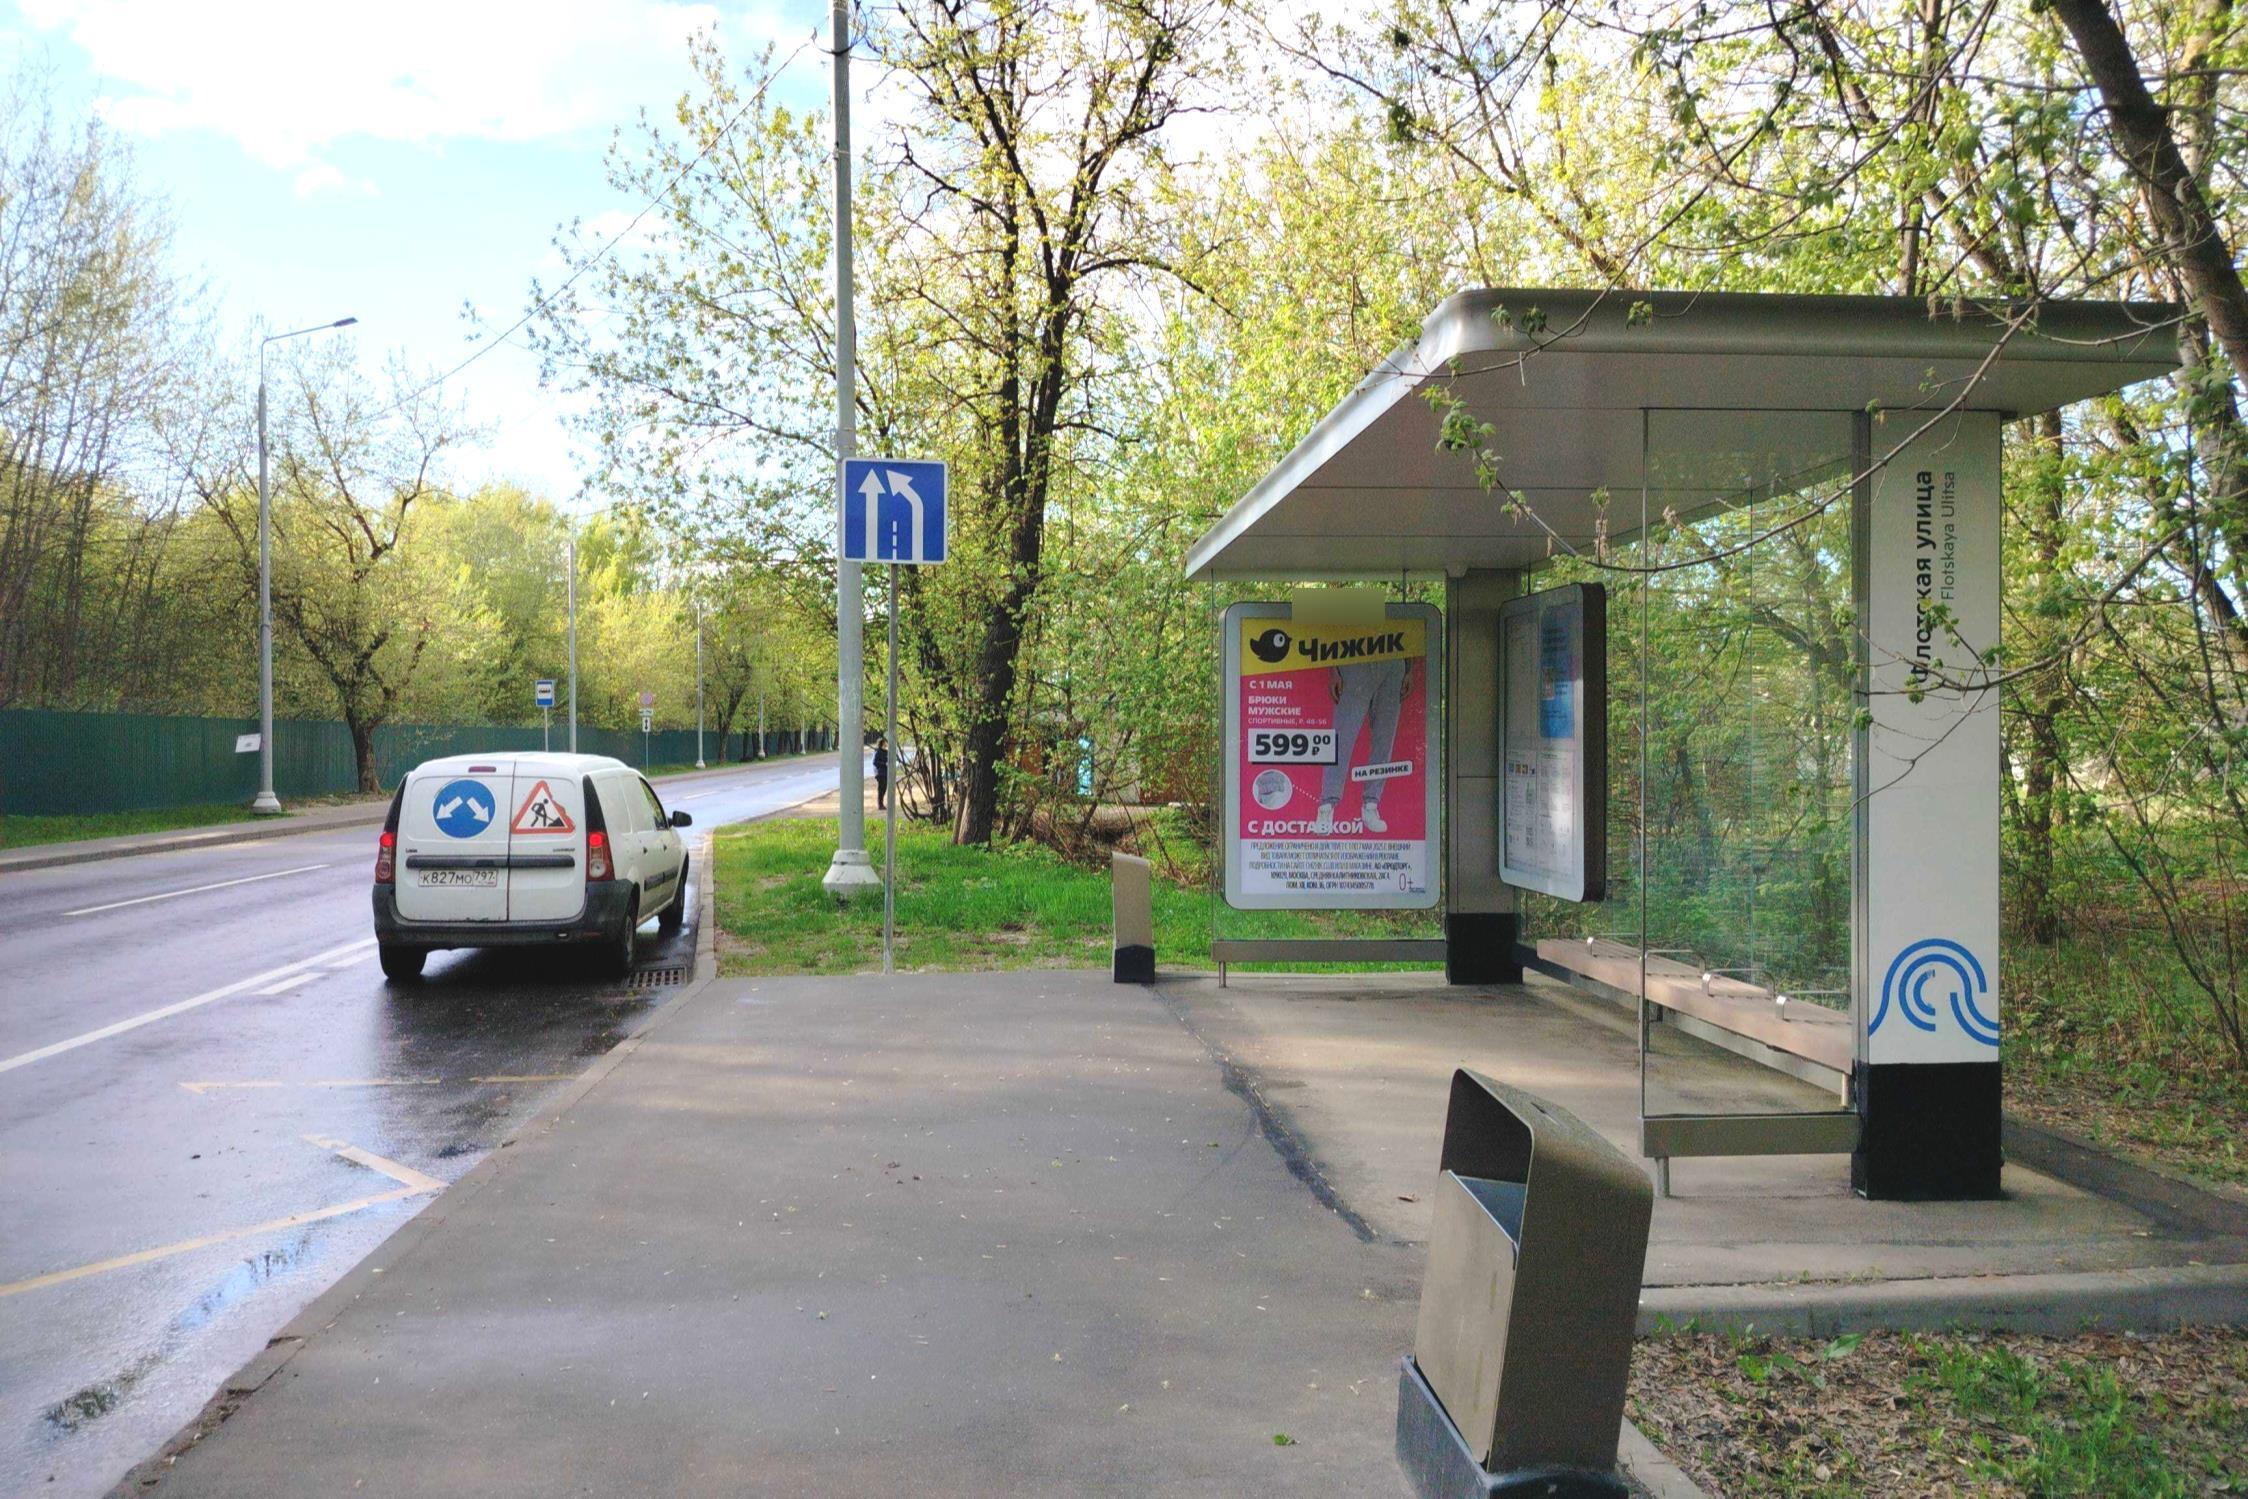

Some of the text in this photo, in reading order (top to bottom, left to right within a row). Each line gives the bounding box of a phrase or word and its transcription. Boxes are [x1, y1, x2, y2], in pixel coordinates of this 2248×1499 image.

[1916, 471, 1936, 550] улица
[1940, 471, 1957, 600] Flotskaya Ulitsa
[1249, 680, 1293, 689] С 1 МАЯ
[1248, 695, 1287, 704] БРЮКИ
[1248, 706, 1301, 715] МУЖСКИЕ
[1255, 733, 1331, 756] 599 00
[1354, 765, 1409, 778] НА РЕЗИНКЕ
[1247, 817, 1363, 836] С ДОСТАВКОЙ
[474, 871, 494, 881] 797
[1398, 872, 1414, 891] 0+
